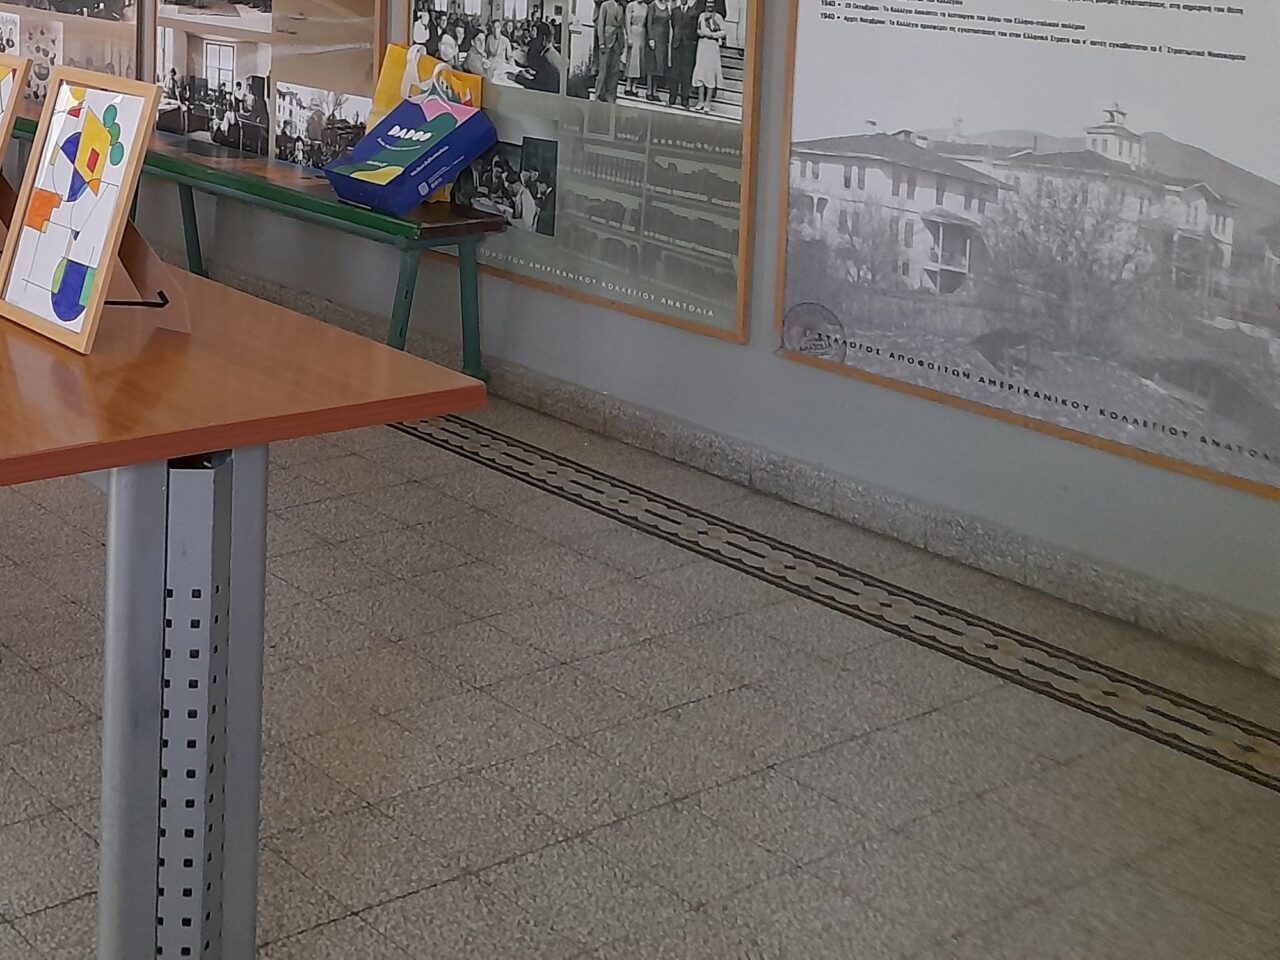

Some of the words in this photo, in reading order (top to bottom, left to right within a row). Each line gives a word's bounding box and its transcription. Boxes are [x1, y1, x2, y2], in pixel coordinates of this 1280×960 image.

[387, 125, 433, 142] DADOO
[661, 298, 715, 316] ΑΝΑΤΟΛΙΑ
[889, 351, 971, 380] ΑΠΟΦΟΙΤΩΝ
[978, 375, 1091, 412] ΑΜΕΡΙΚΑΝΙΚΟΥ
